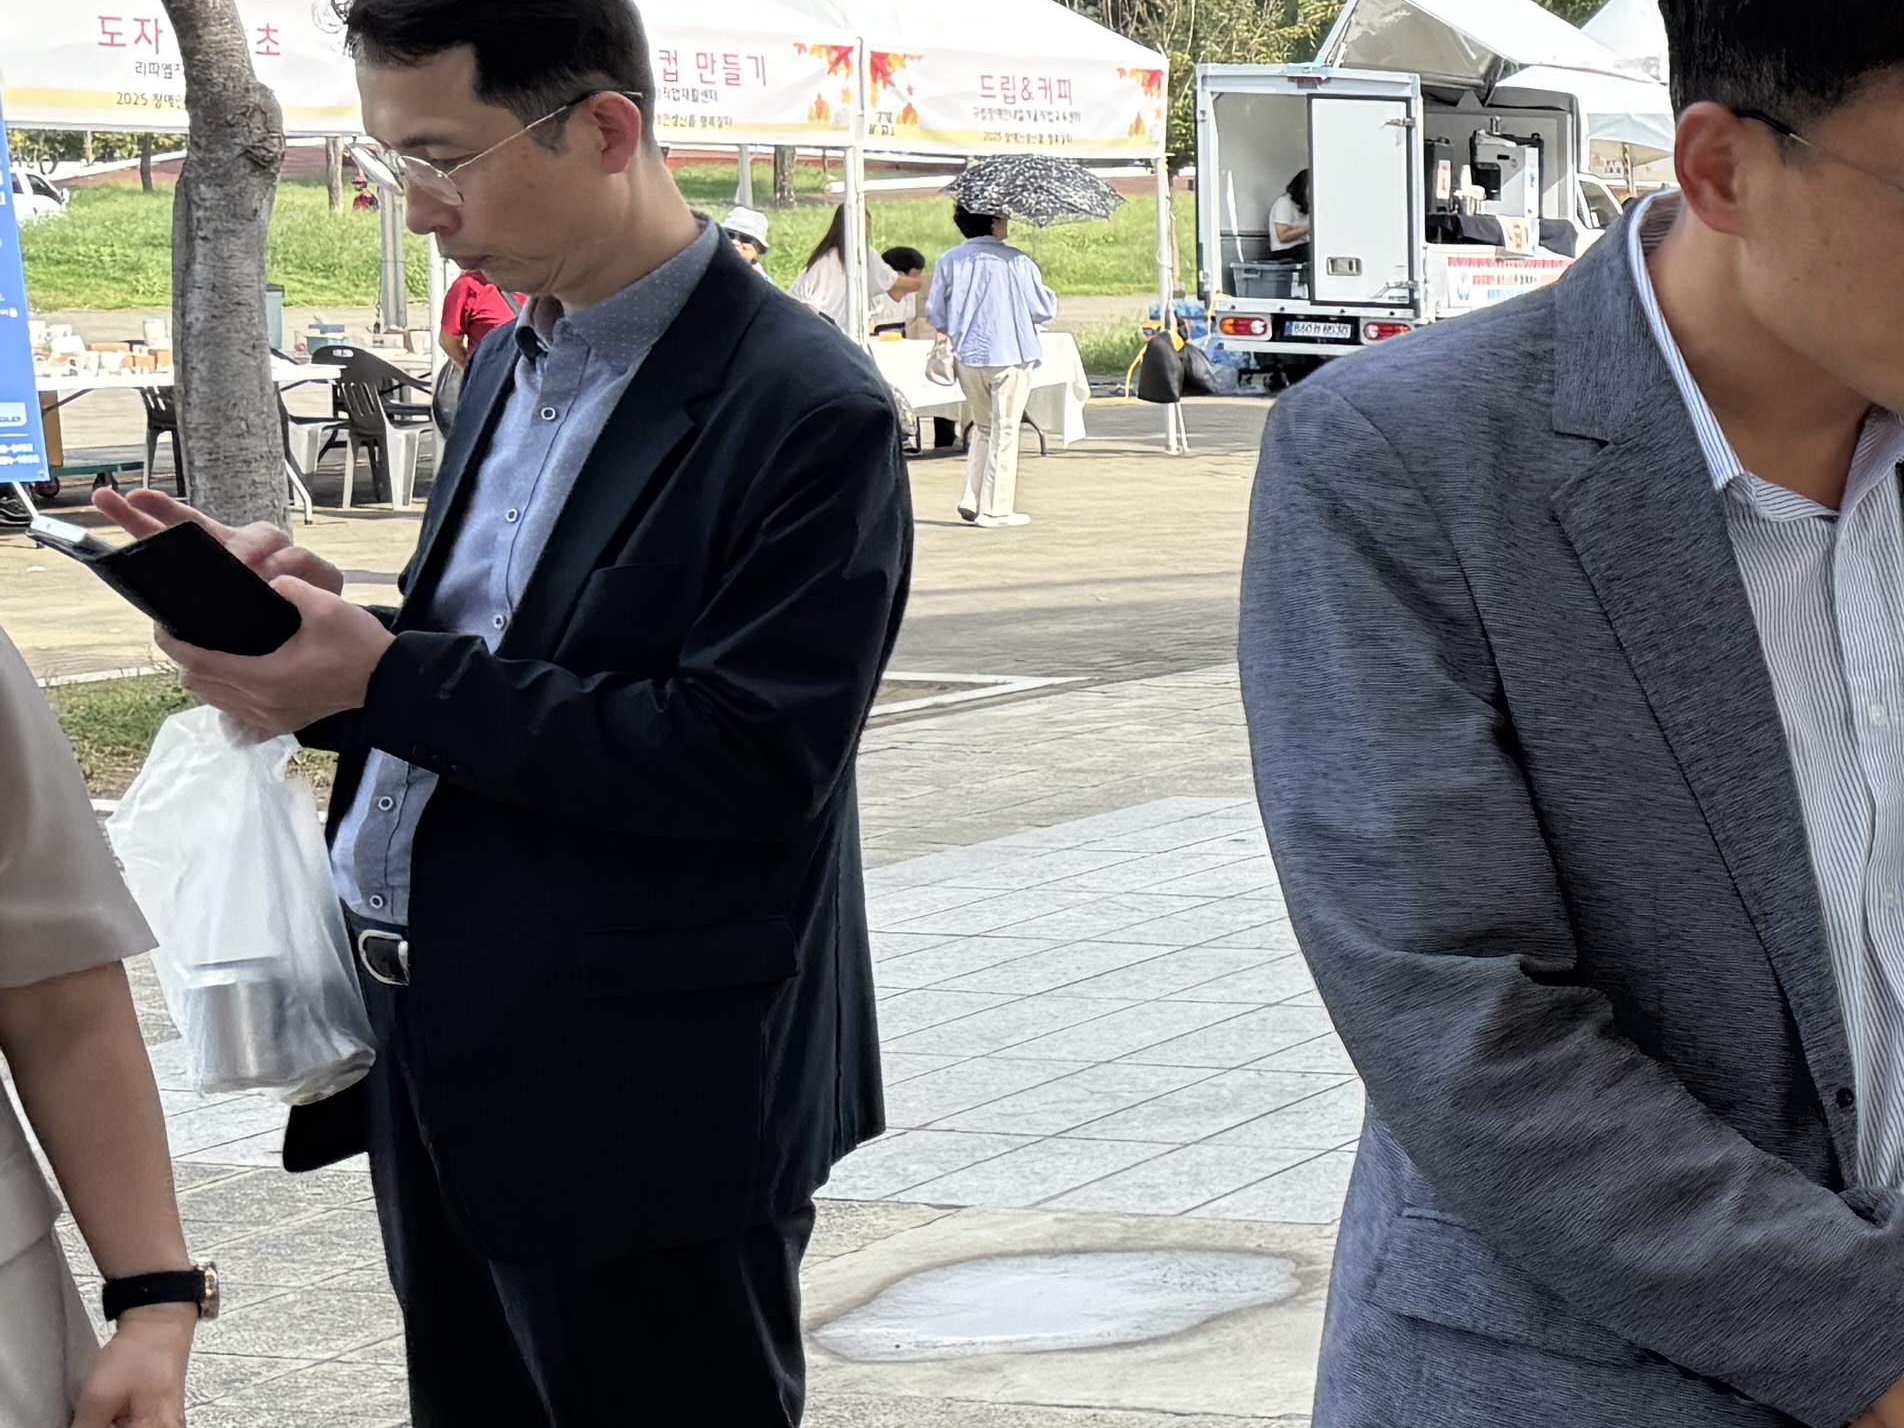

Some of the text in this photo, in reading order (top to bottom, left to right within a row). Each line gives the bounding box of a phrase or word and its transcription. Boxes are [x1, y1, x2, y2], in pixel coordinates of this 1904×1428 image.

[696, 52, 767, 87] 만들기
[116, 91, 149, 107] 2025
[980, 74, 1073, 105] 드립&커피
